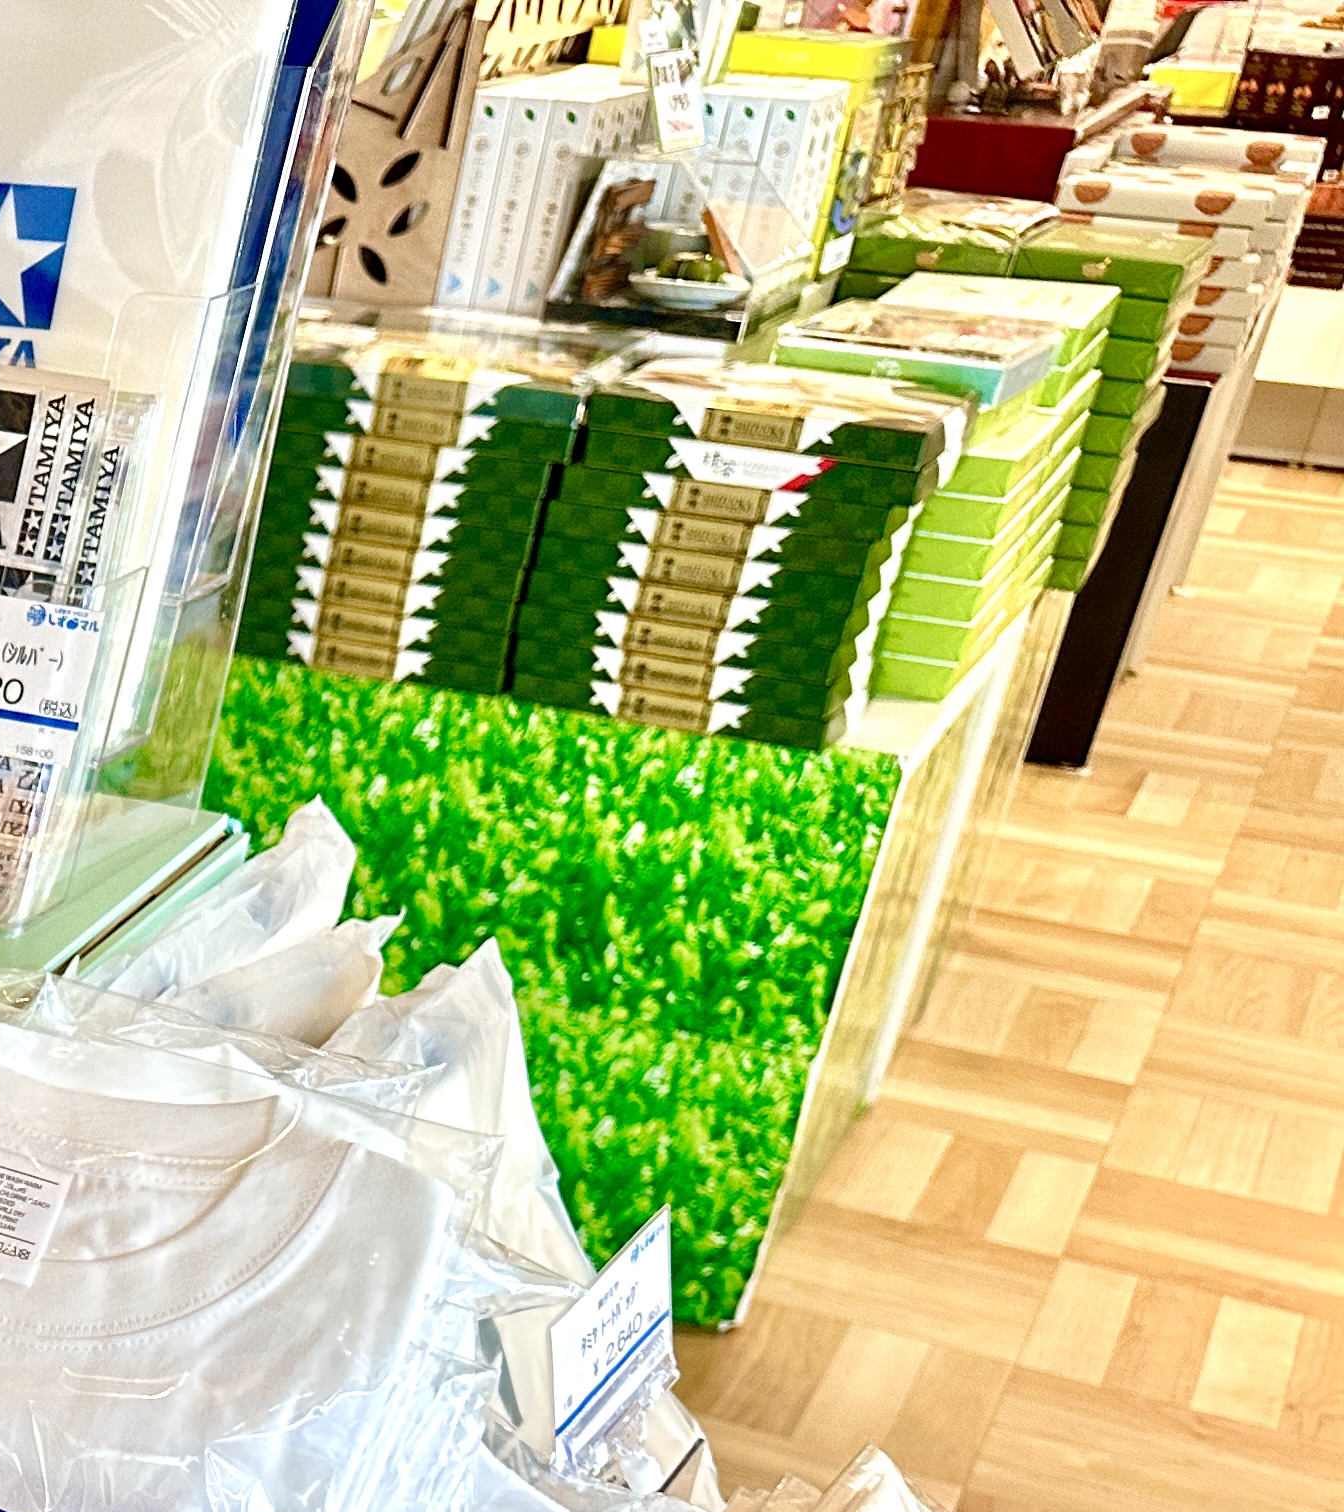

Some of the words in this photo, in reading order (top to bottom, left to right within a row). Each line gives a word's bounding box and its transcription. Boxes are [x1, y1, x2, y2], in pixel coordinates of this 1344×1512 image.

[31, 395, 66, 506] TAMIYA
[57, 398, 94, 510] TAMIYA
[82, 445, 119, 559] TAMIYA
[38, 699, 78, 719] (税込)
